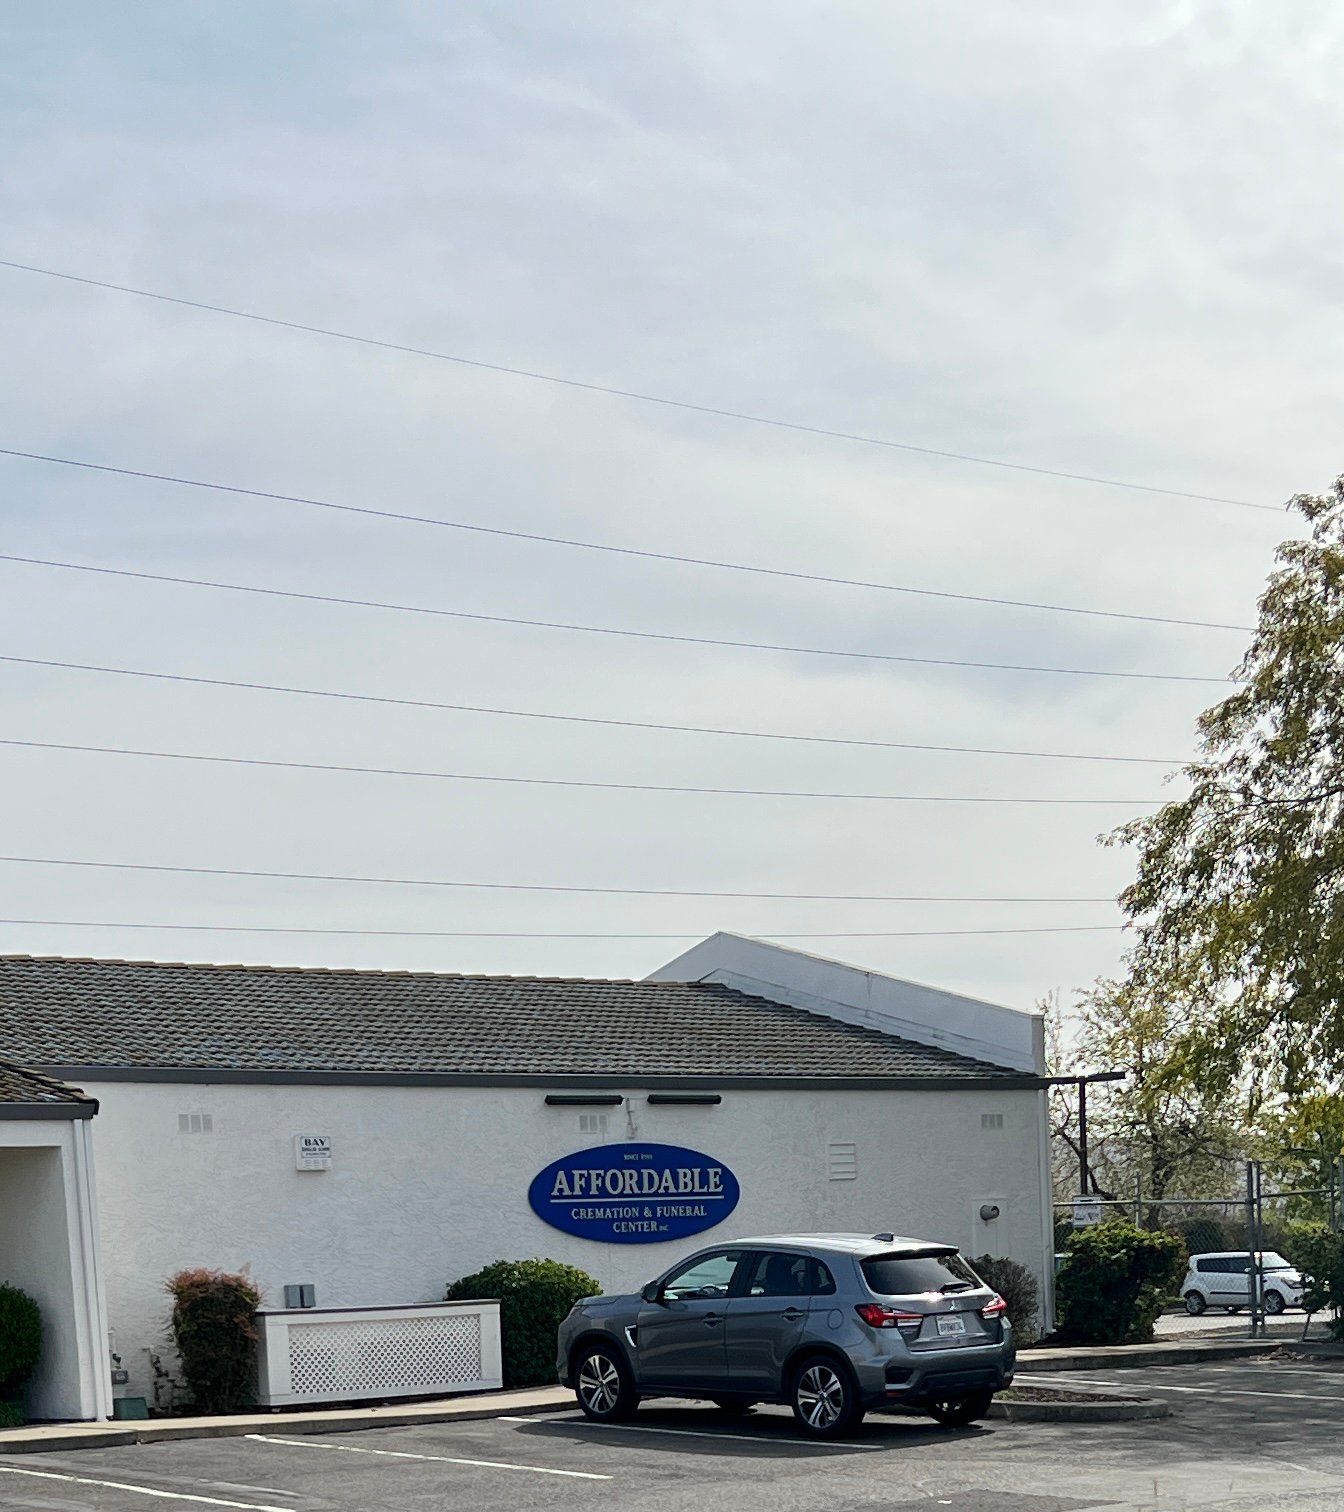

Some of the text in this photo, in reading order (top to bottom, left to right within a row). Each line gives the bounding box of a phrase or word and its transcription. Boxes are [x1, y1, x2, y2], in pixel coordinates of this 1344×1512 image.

[304, 1138, 326, 1146] BAY
[551, 1168, 724, 1196] AFFORDABLE
[571, 1205, 707, 1219] CREMATION & FUNERAL
[612, 1221, 657, 1233] CENTER
